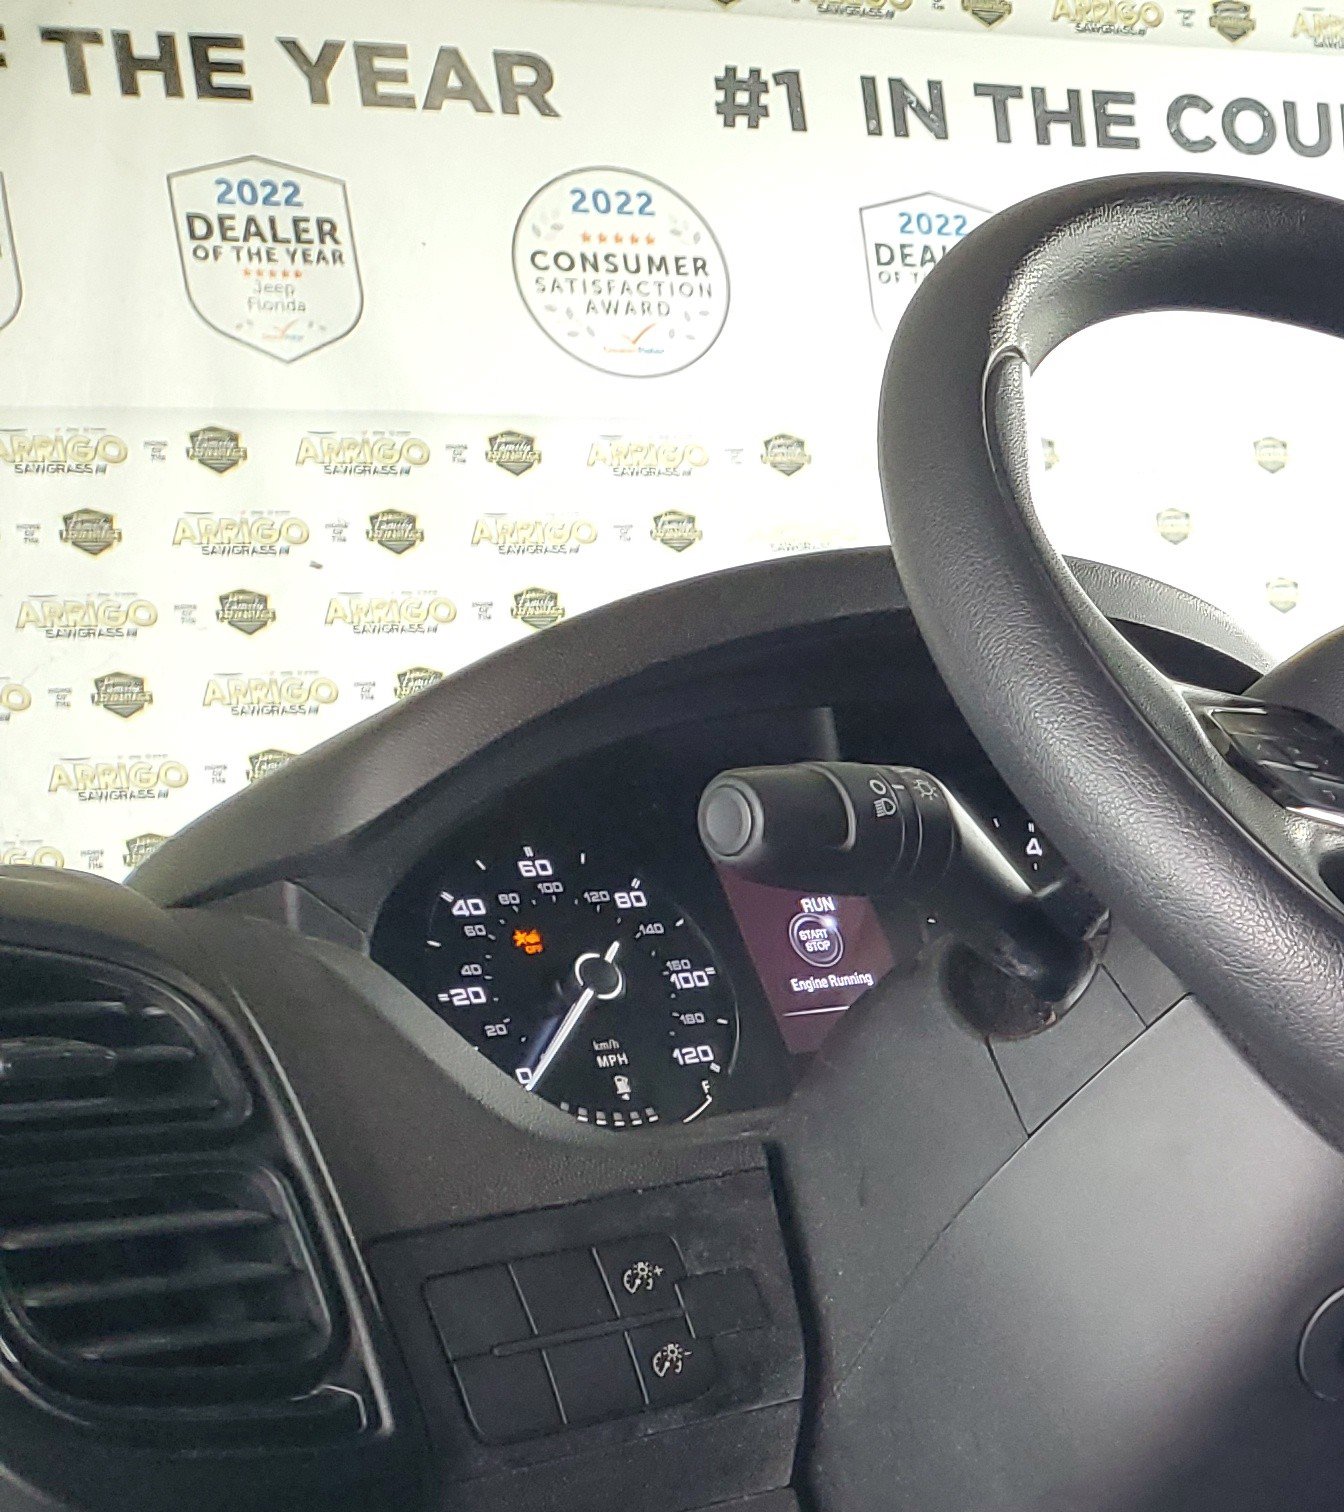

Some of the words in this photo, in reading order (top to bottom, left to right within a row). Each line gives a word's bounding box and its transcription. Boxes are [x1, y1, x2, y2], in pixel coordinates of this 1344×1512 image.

[39, 26, 254, 101] THE
[275, 36, 562, 118] YEAR
[714, 65, 808, 132] #1
[860, 75, 949, 140] IN
[974, 82, 1141, 150] THE
[214, 177, 305, 207] 2022
[570, 187, 656, 217] 2022
[185, 211, 342, 245] DEALER
[898, 211, 969, 237] 2022
[192, 244, 223, 262] OF
[231, 245, 279, 264] THE
[285, 247, 346, 266] YEAR
[530, 249, 710, 278] CONSUMER
[874, 243, 948, 268] DEA
[535, 276, 712, 299] SATISFACTION
[586, 298, 671, 317] AWARD
[172, 516, 310, 546] ARRIGO
[16, 598, 158, 629] ARRIGO
[202, 677, 339, 707] ARRIGO
[48, 761, 189, 792] ARRIGO
[1026, 837, 1043, 857] 4
[517, 859, 553, 877] 60
[537, 881, 564, 893] 100
[583, 890, 611, 903] 120
[451, 898, 487, 917] 40
[613, 890, 648, 909] 80
[800, 896, 837, 914] RUN
[463, 924, 487, 937] 60
[638, 922, 665, 936] 140
[798, 928, 829, 941] START
[805, 940, 831, 953] STOP
[460, 963, 483, 977] 40
[670, 970, 710, 990] 100
[790, 976, 829, 993] Engine
[827, 971, 875, 987] Running
[449, 987, 487, 1006] 20
[484, 1024, 508, 1038] 20
[592, 1039, 620, 1051] km/h
[596, 1052, 629, 1069] MPH
[672, 1044, 715, 1066] 120
[515, 1067, 533, 1085] 0
[701, 1079, 711, 1094] F
